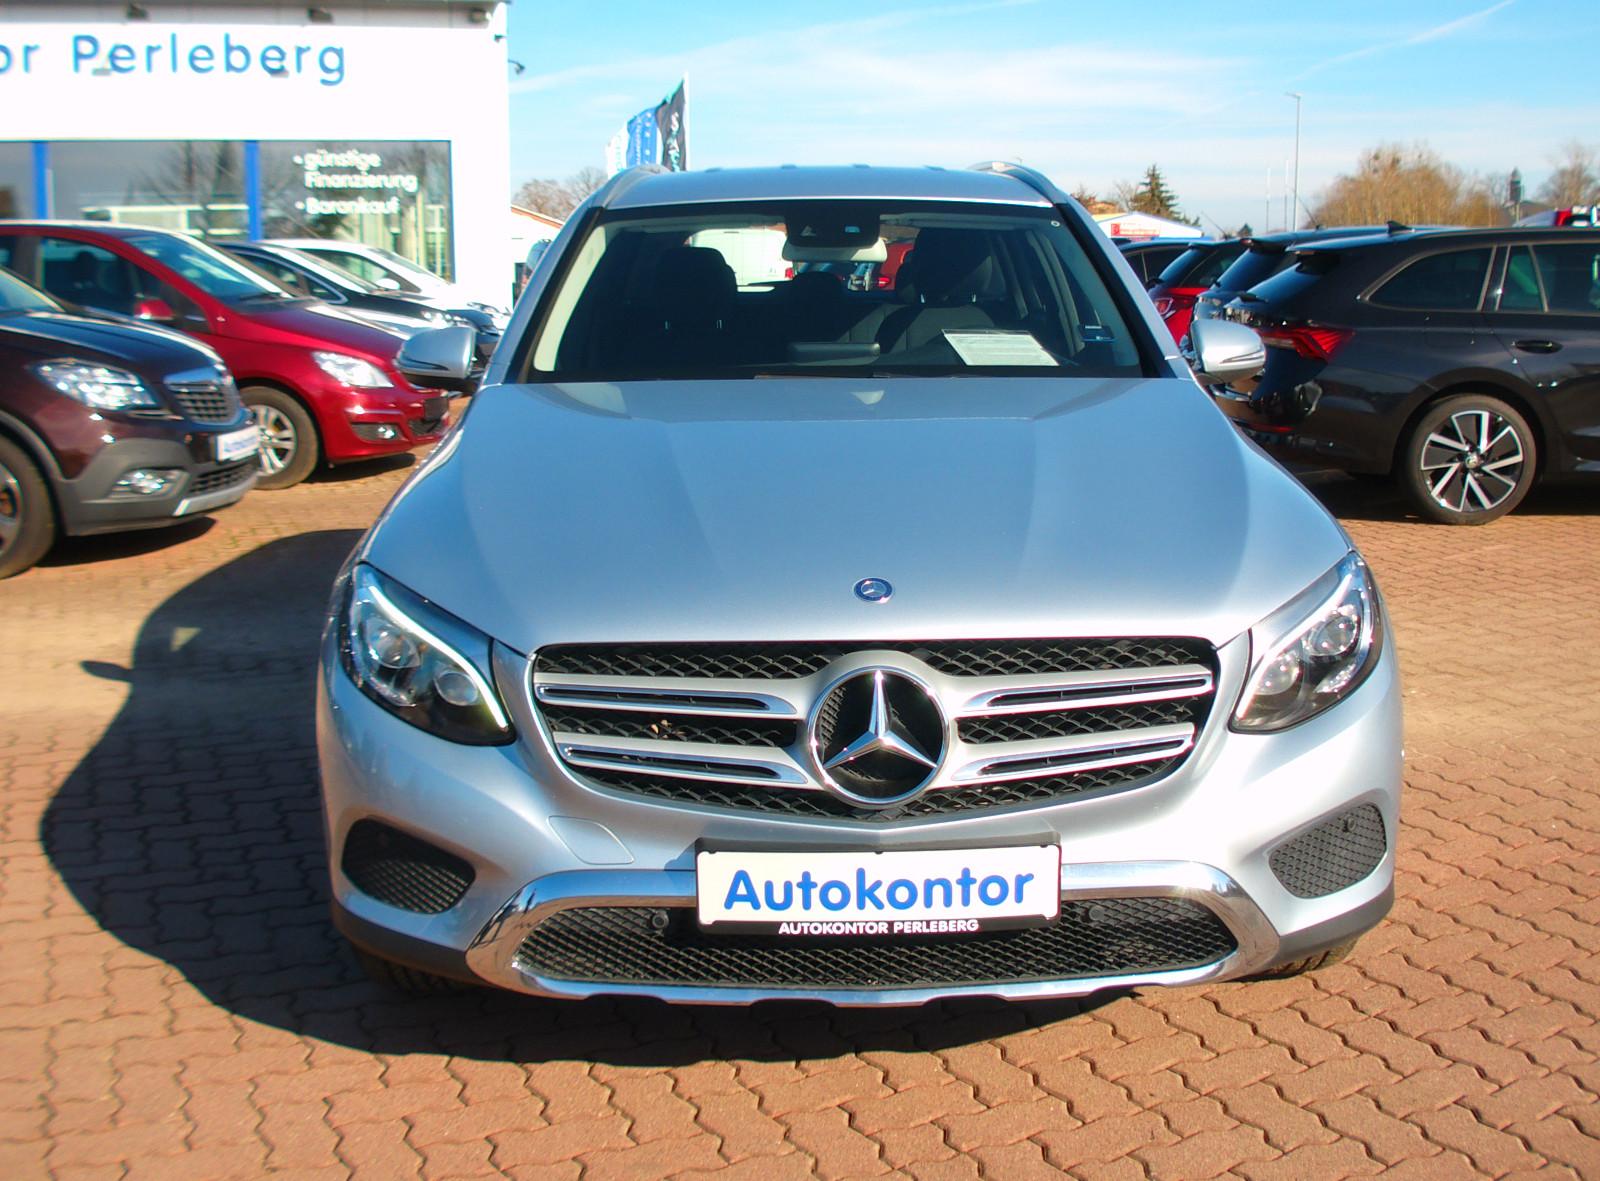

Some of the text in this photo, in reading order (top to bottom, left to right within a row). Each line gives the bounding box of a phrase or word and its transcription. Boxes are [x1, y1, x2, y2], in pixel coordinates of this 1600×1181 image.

[72, 32, 345, 86] Perleberg
[304, 149, 382, 170] günstige
[304, 170, 418, 192] Finanzierung
[724, 867, 1034, 911] Autokontor
[778, 919, 979, 935] AUTOKONTOR PERLEBERG
